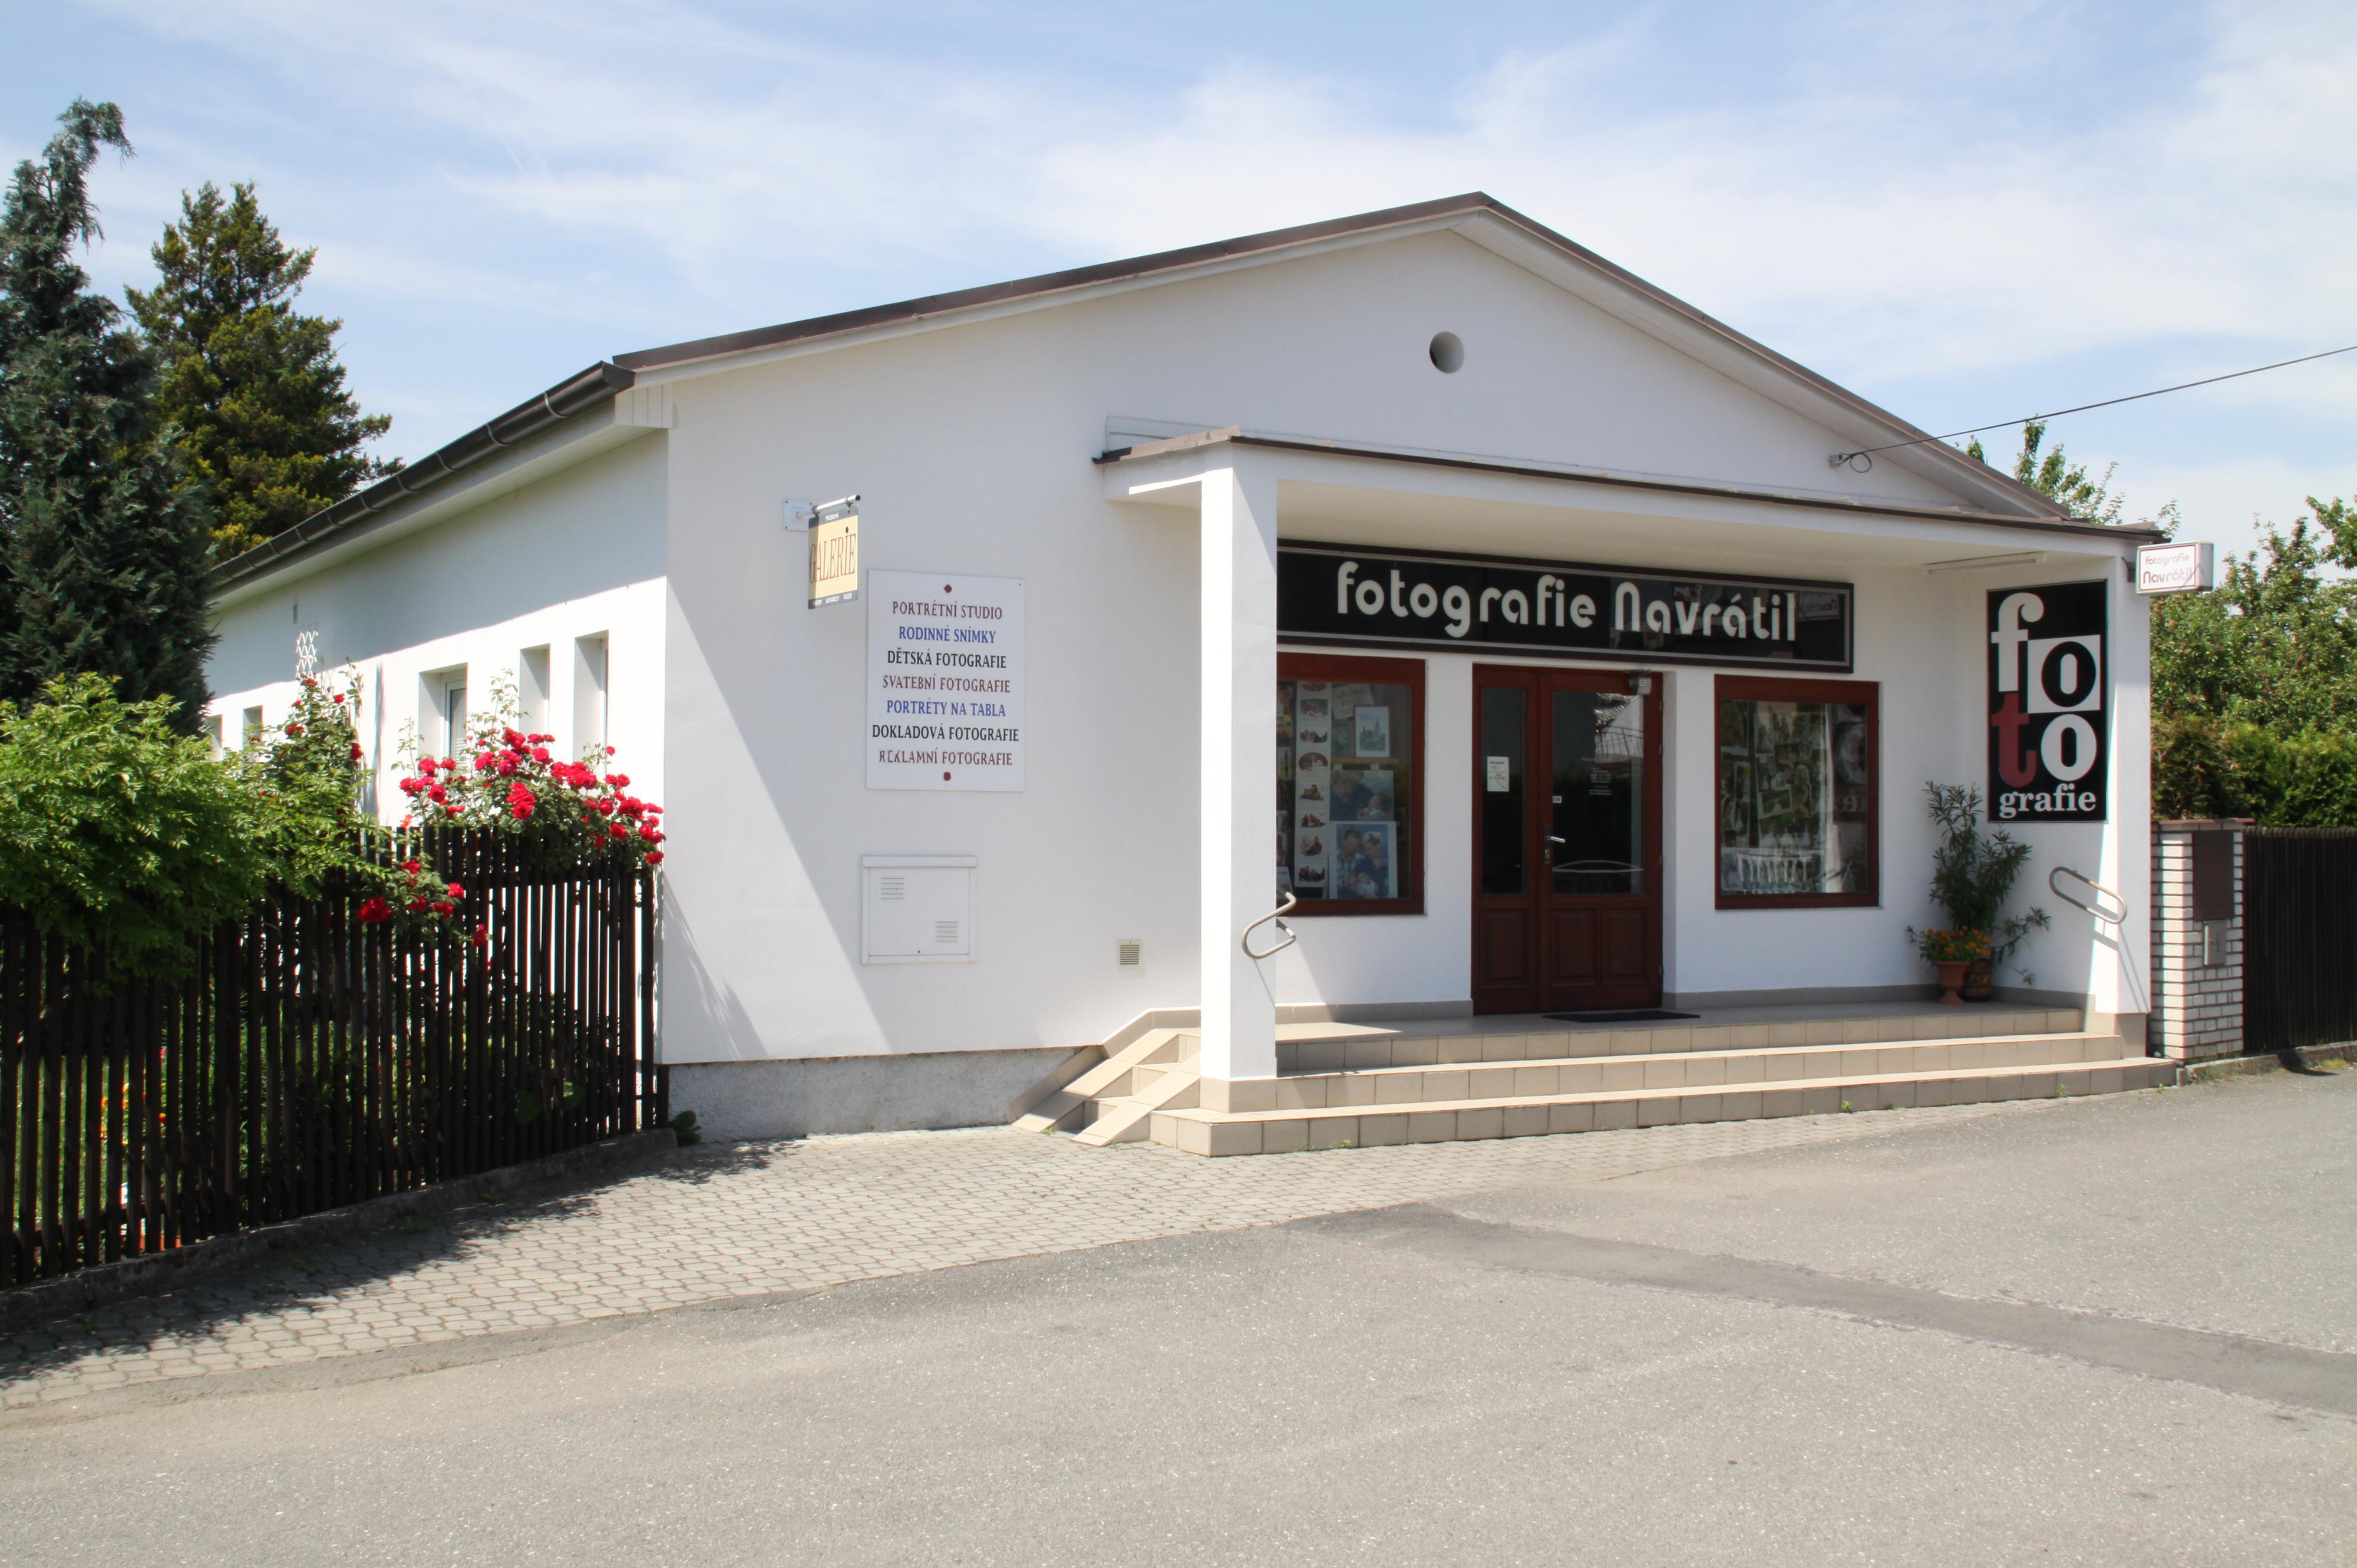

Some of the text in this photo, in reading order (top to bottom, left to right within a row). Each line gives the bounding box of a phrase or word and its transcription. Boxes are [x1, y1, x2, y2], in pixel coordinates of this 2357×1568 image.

[810, 533, 856, 584] GALERIE
[2145, 553, 2190, 566] fotografie
[2143, 567, 2193, 584] Navrátil
[893, 599, 1002, 620] PORTRÉTNÍ STUDIO
[1338, 562, 1795, 641] fotografie Navrátil
[899, 625, 996, 643] RODINNÉ SNÍMKY
[887, 647, 1006, 669] DĚTSKÁ FOTOGRAFIE
[882, 674, 1011, 693] SVATEBNÍ FOTOGRAFIE
[886, 698, 1006, 717] PORTRÉTY NA TABLA
[872, 722, 1019, 742] DOKLADOVÁ FOTOGRAFIE
[942, 751, 1012, 765] FOTOGRAFIE
[1999, 783, 2096, 818] grafie
